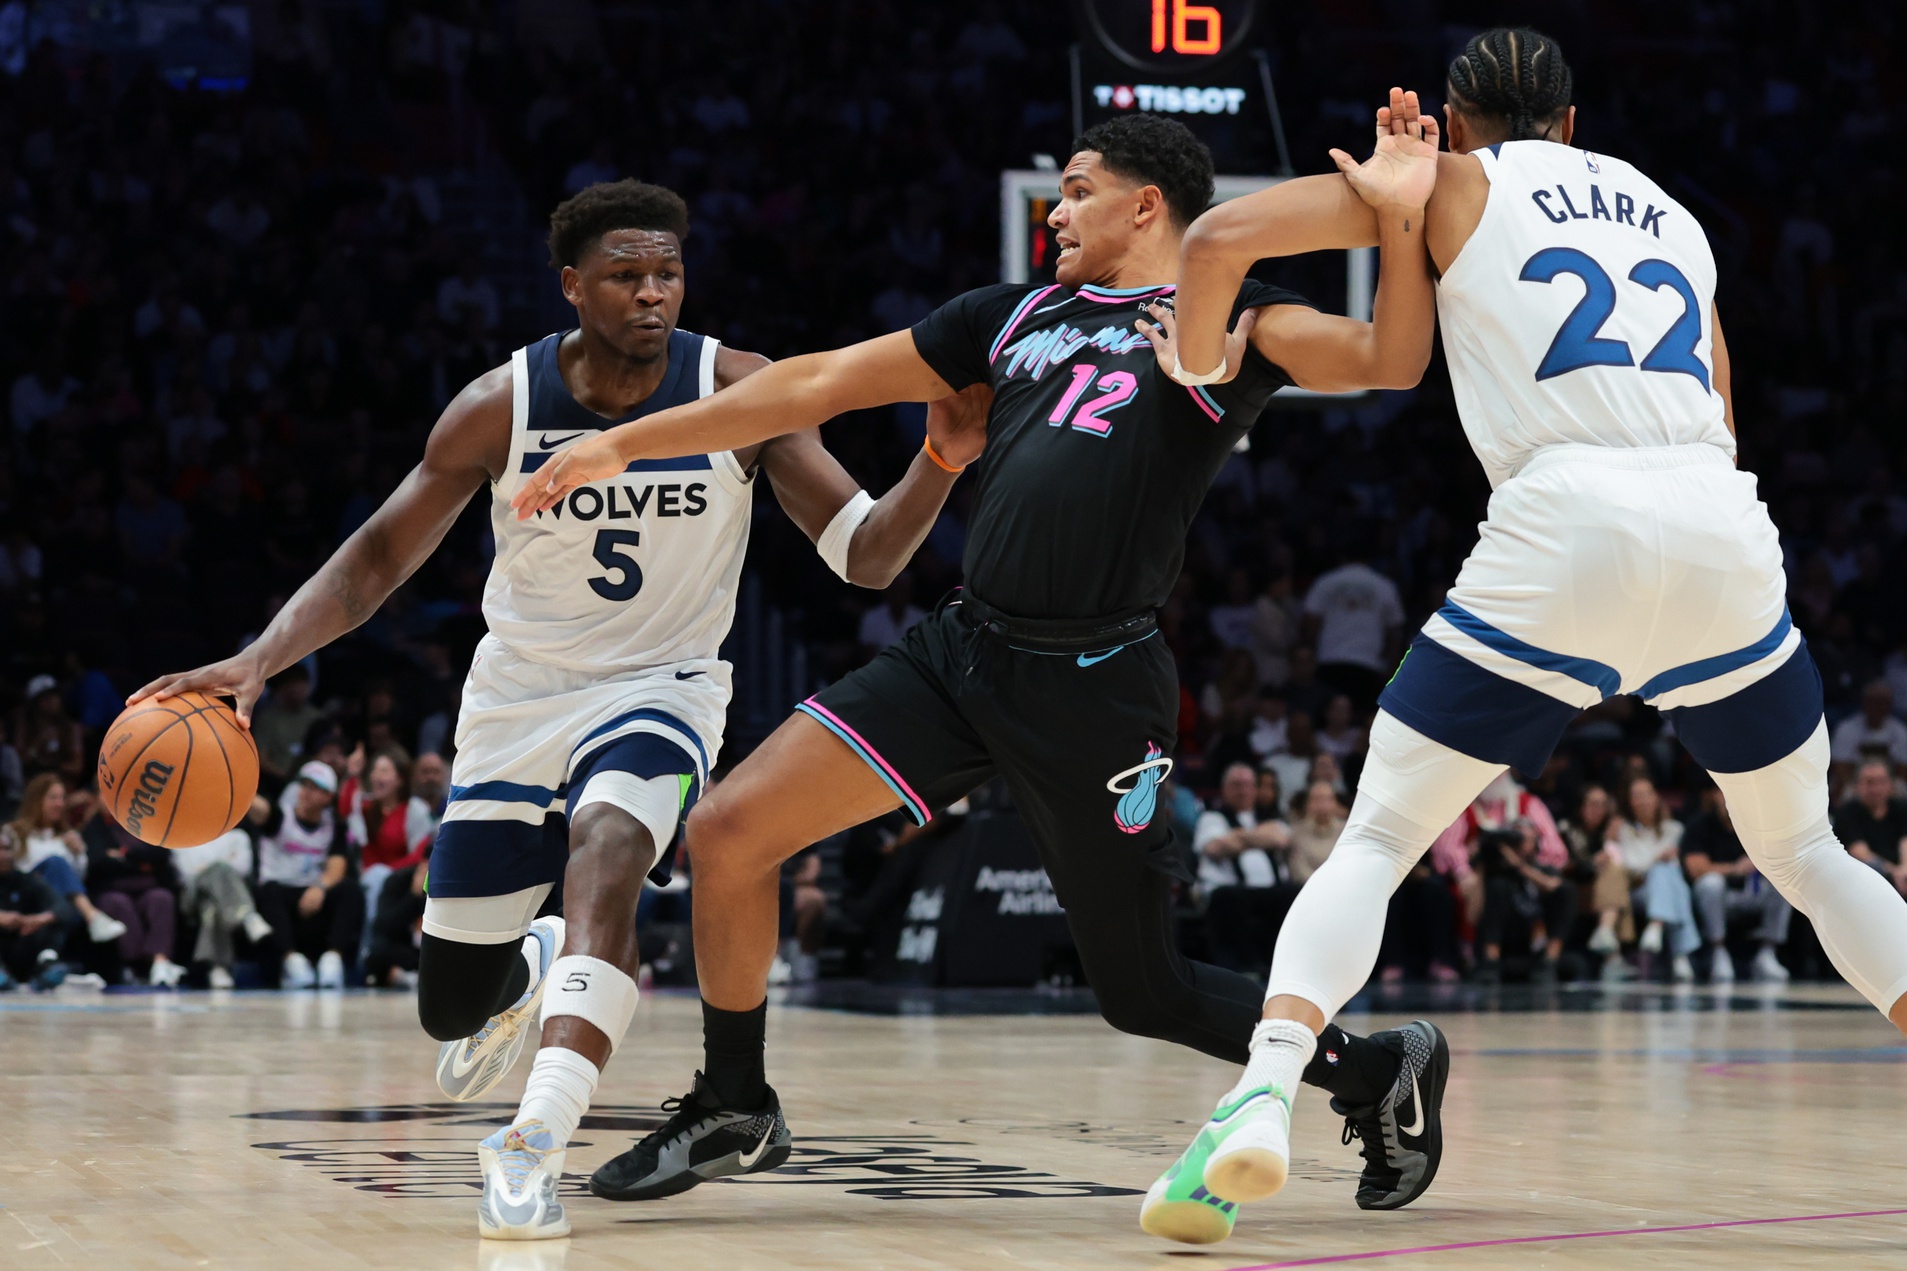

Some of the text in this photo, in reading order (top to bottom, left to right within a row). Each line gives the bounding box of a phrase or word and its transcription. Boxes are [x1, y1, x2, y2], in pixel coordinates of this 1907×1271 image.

[1151, 0, 1221, 55] 16
[1134, 84, 1246, 115] TISSOT
[1531, 184, 1668, 239] CLARK
[1518, 246, 1711, 398] 22
[1048, 364, 1139, 438] 12
[535, 482, 708, 521] OLVES
[587, 528, 644, 602] 5
[562, 972, 591, 991] 5
